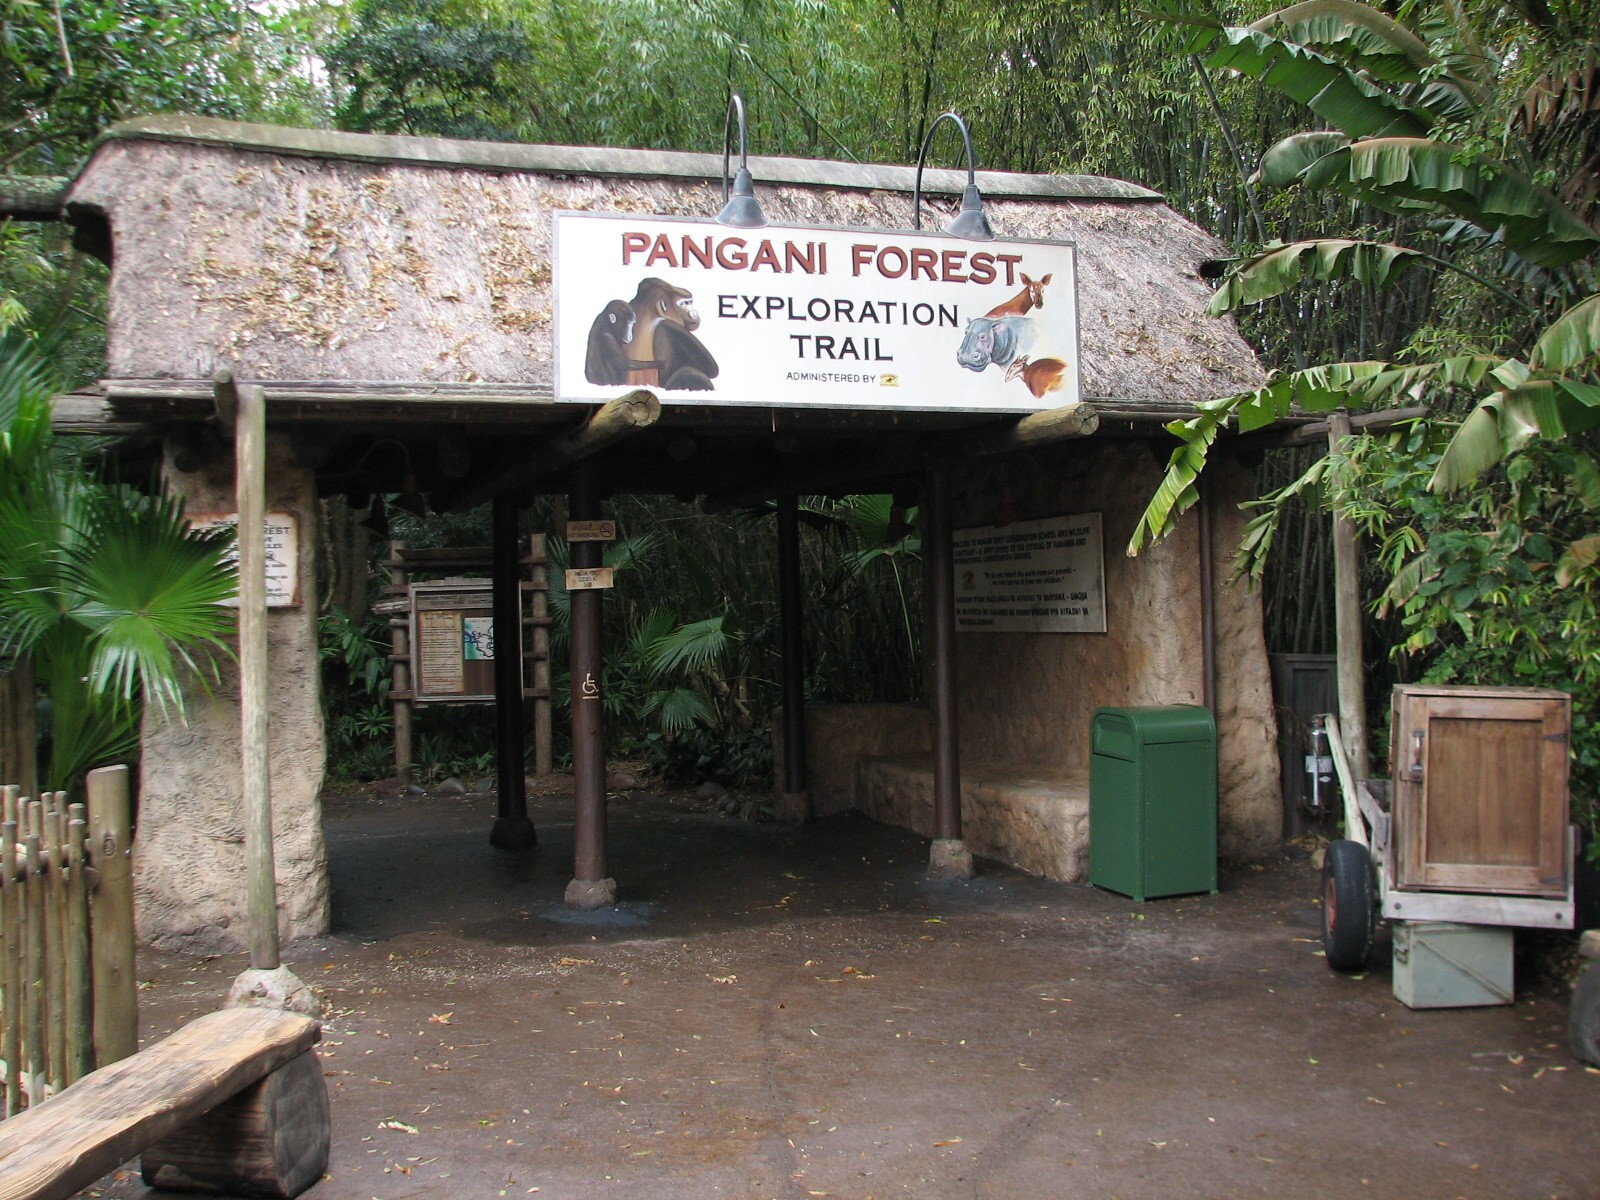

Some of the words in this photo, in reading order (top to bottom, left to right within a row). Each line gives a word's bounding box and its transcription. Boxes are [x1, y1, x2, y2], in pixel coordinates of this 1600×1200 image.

[621, 232, 828, 275] PANGANI
[851, 243, 1023, 286] FOREST
[717, 294, 959, 328] EXPLORATION
[790, 334, 893, 362] TRAIL
[786, 372, 861, 383] ADMINISTERED
[863, 375, 876, 384] BY
[264, 526, 290, 534] REST
